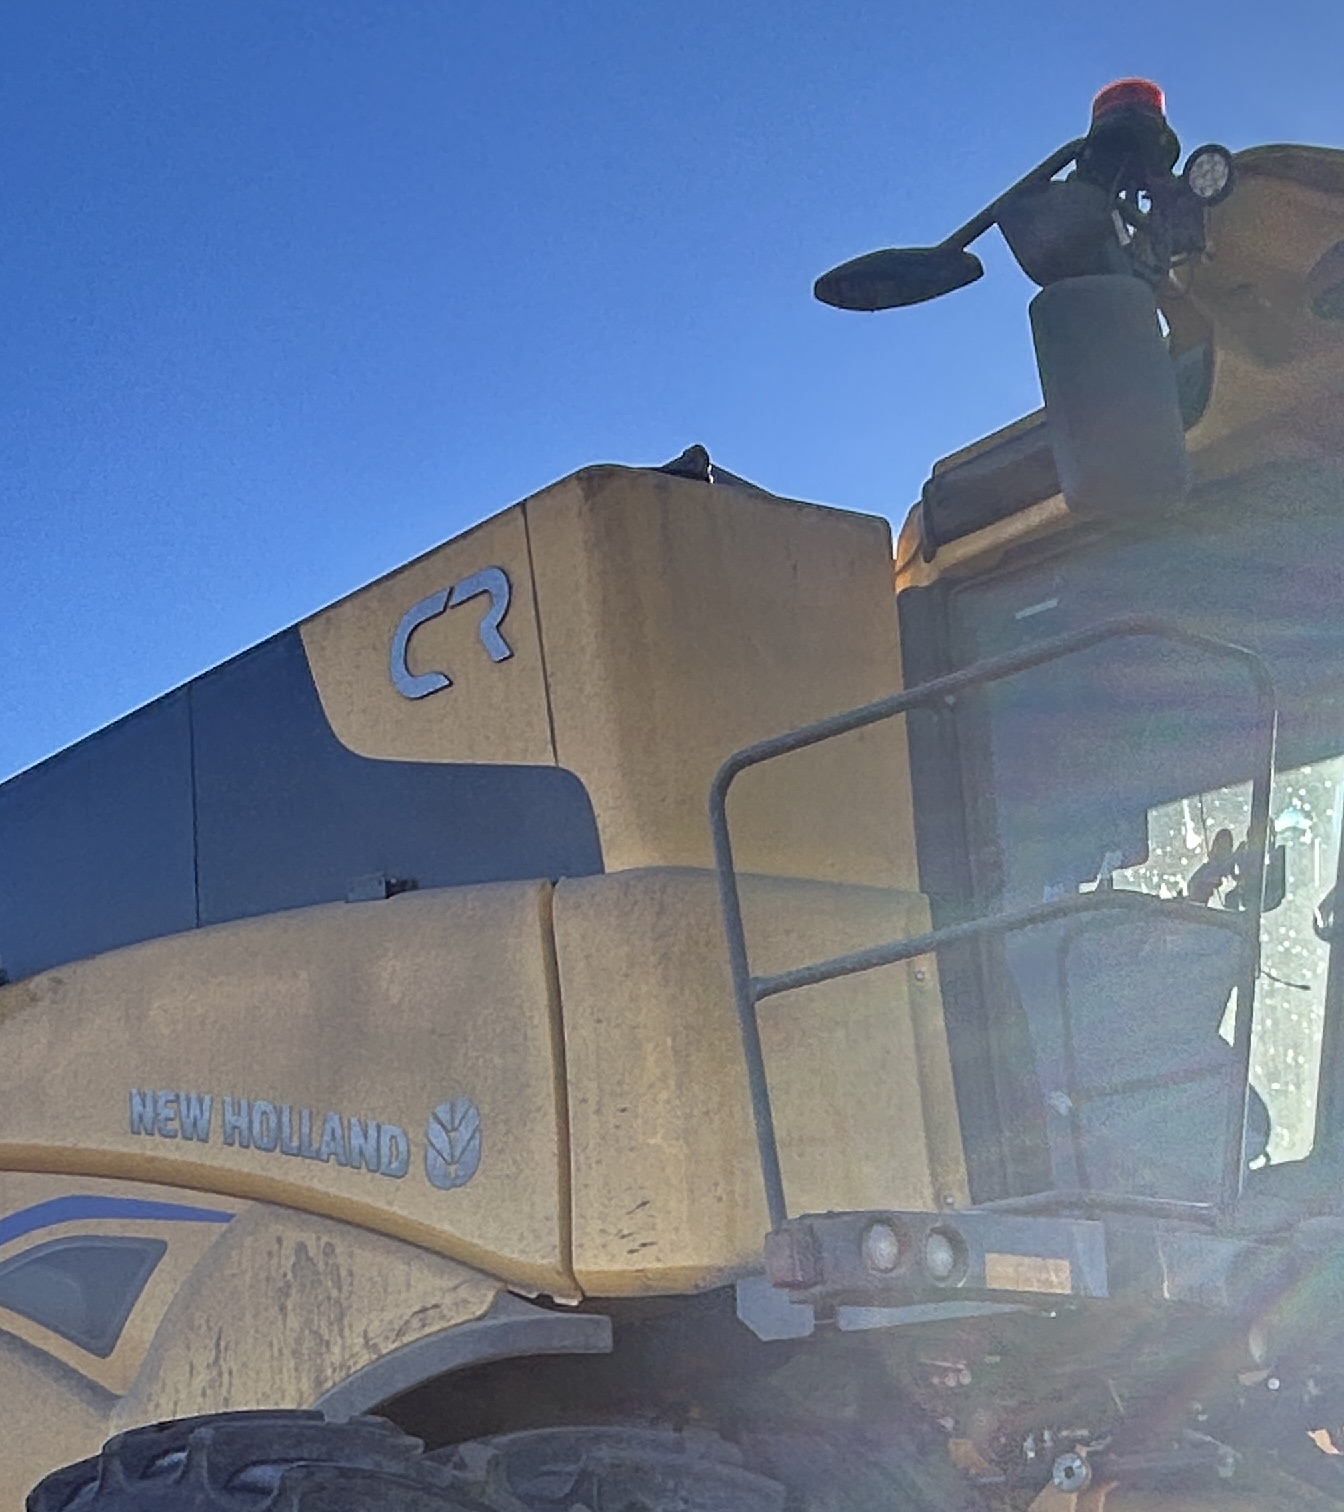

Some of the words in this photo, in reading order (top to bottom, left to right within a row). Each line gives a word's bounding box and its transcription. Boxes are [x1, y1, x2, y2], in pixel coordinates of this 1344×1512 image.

[389, 565, 514, 700] CR
[129, 1088, 213, 1143] NEW
[222, 1096, 410, 1179] HOLLAND
